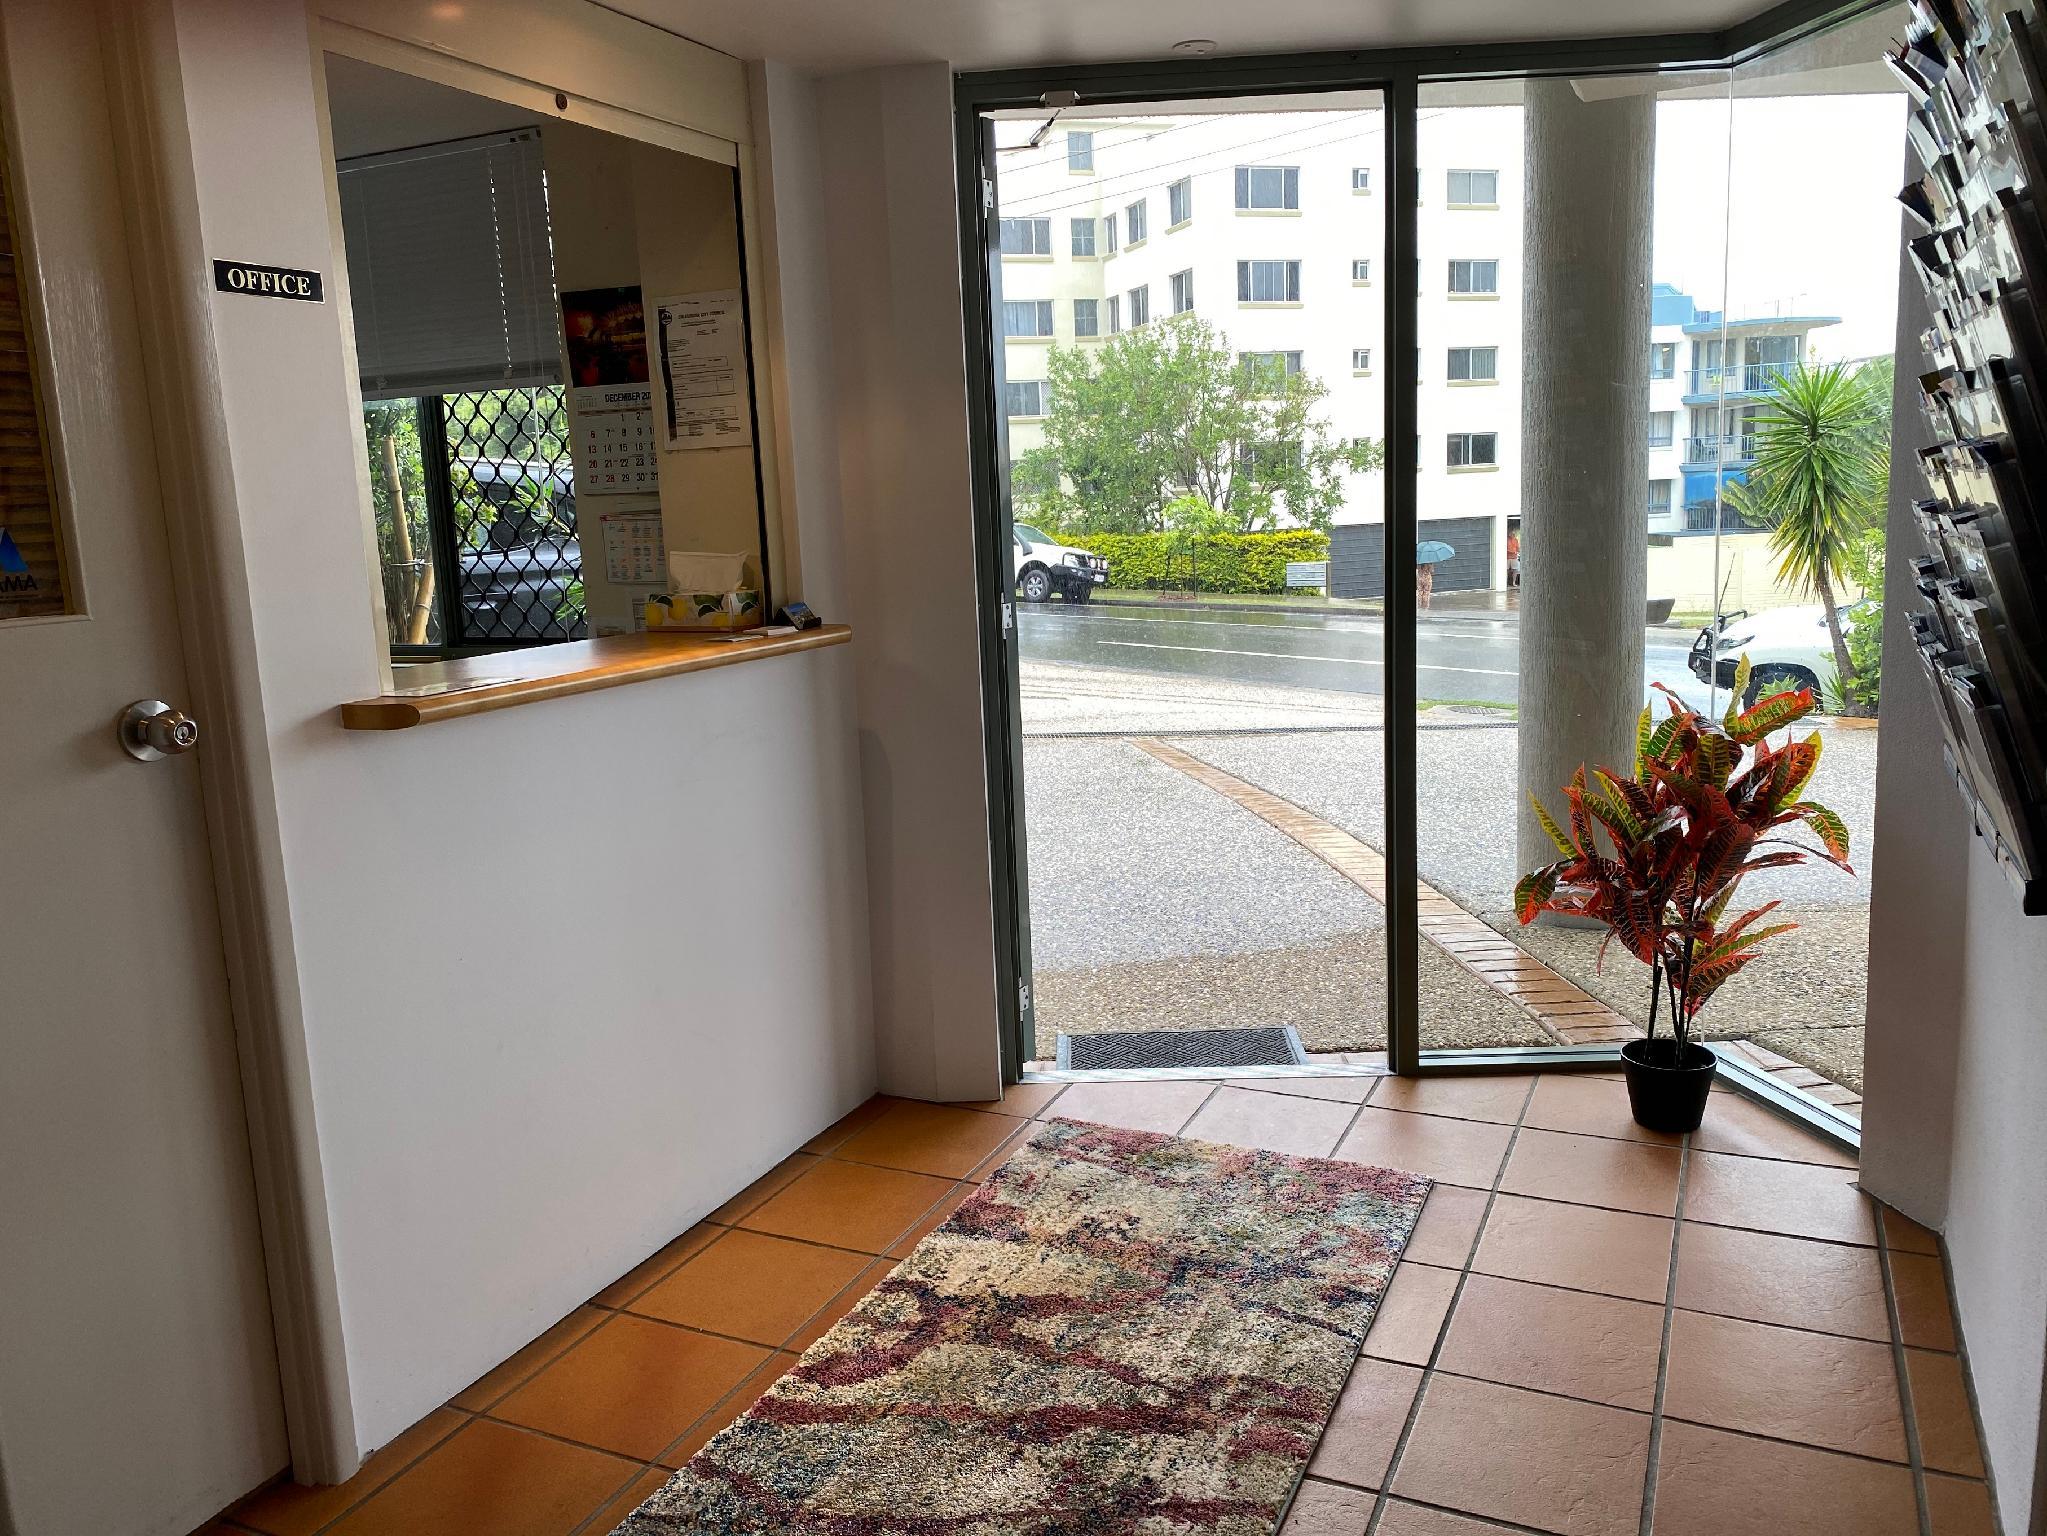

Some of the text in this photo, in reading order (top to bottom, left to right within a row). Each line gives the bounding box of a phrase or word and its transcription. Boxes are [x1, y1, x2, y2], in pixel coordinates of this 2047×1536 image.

[227, 268, 311, 296] OFFICE
[605, 392, 640, 402] DECEMBER
[637, 412, 640, 420] 2
[606, 429, 610, 437] 7
[637, 428, 641, 436] 9
[588, 445, 596, 454] 13
[603, 444, 611, 453] 14
[619, 444, 627, 452] 15
[635, 443, 643, 451] 16
[605, 460, 612, 468] 21
[621, 459, 628, 467] 22
[636, 458, 644, 466] 23
[590, 475, 598, 483] 27
[622, 474, 629, 482] 29
[637, 473, 645, 481] 30
